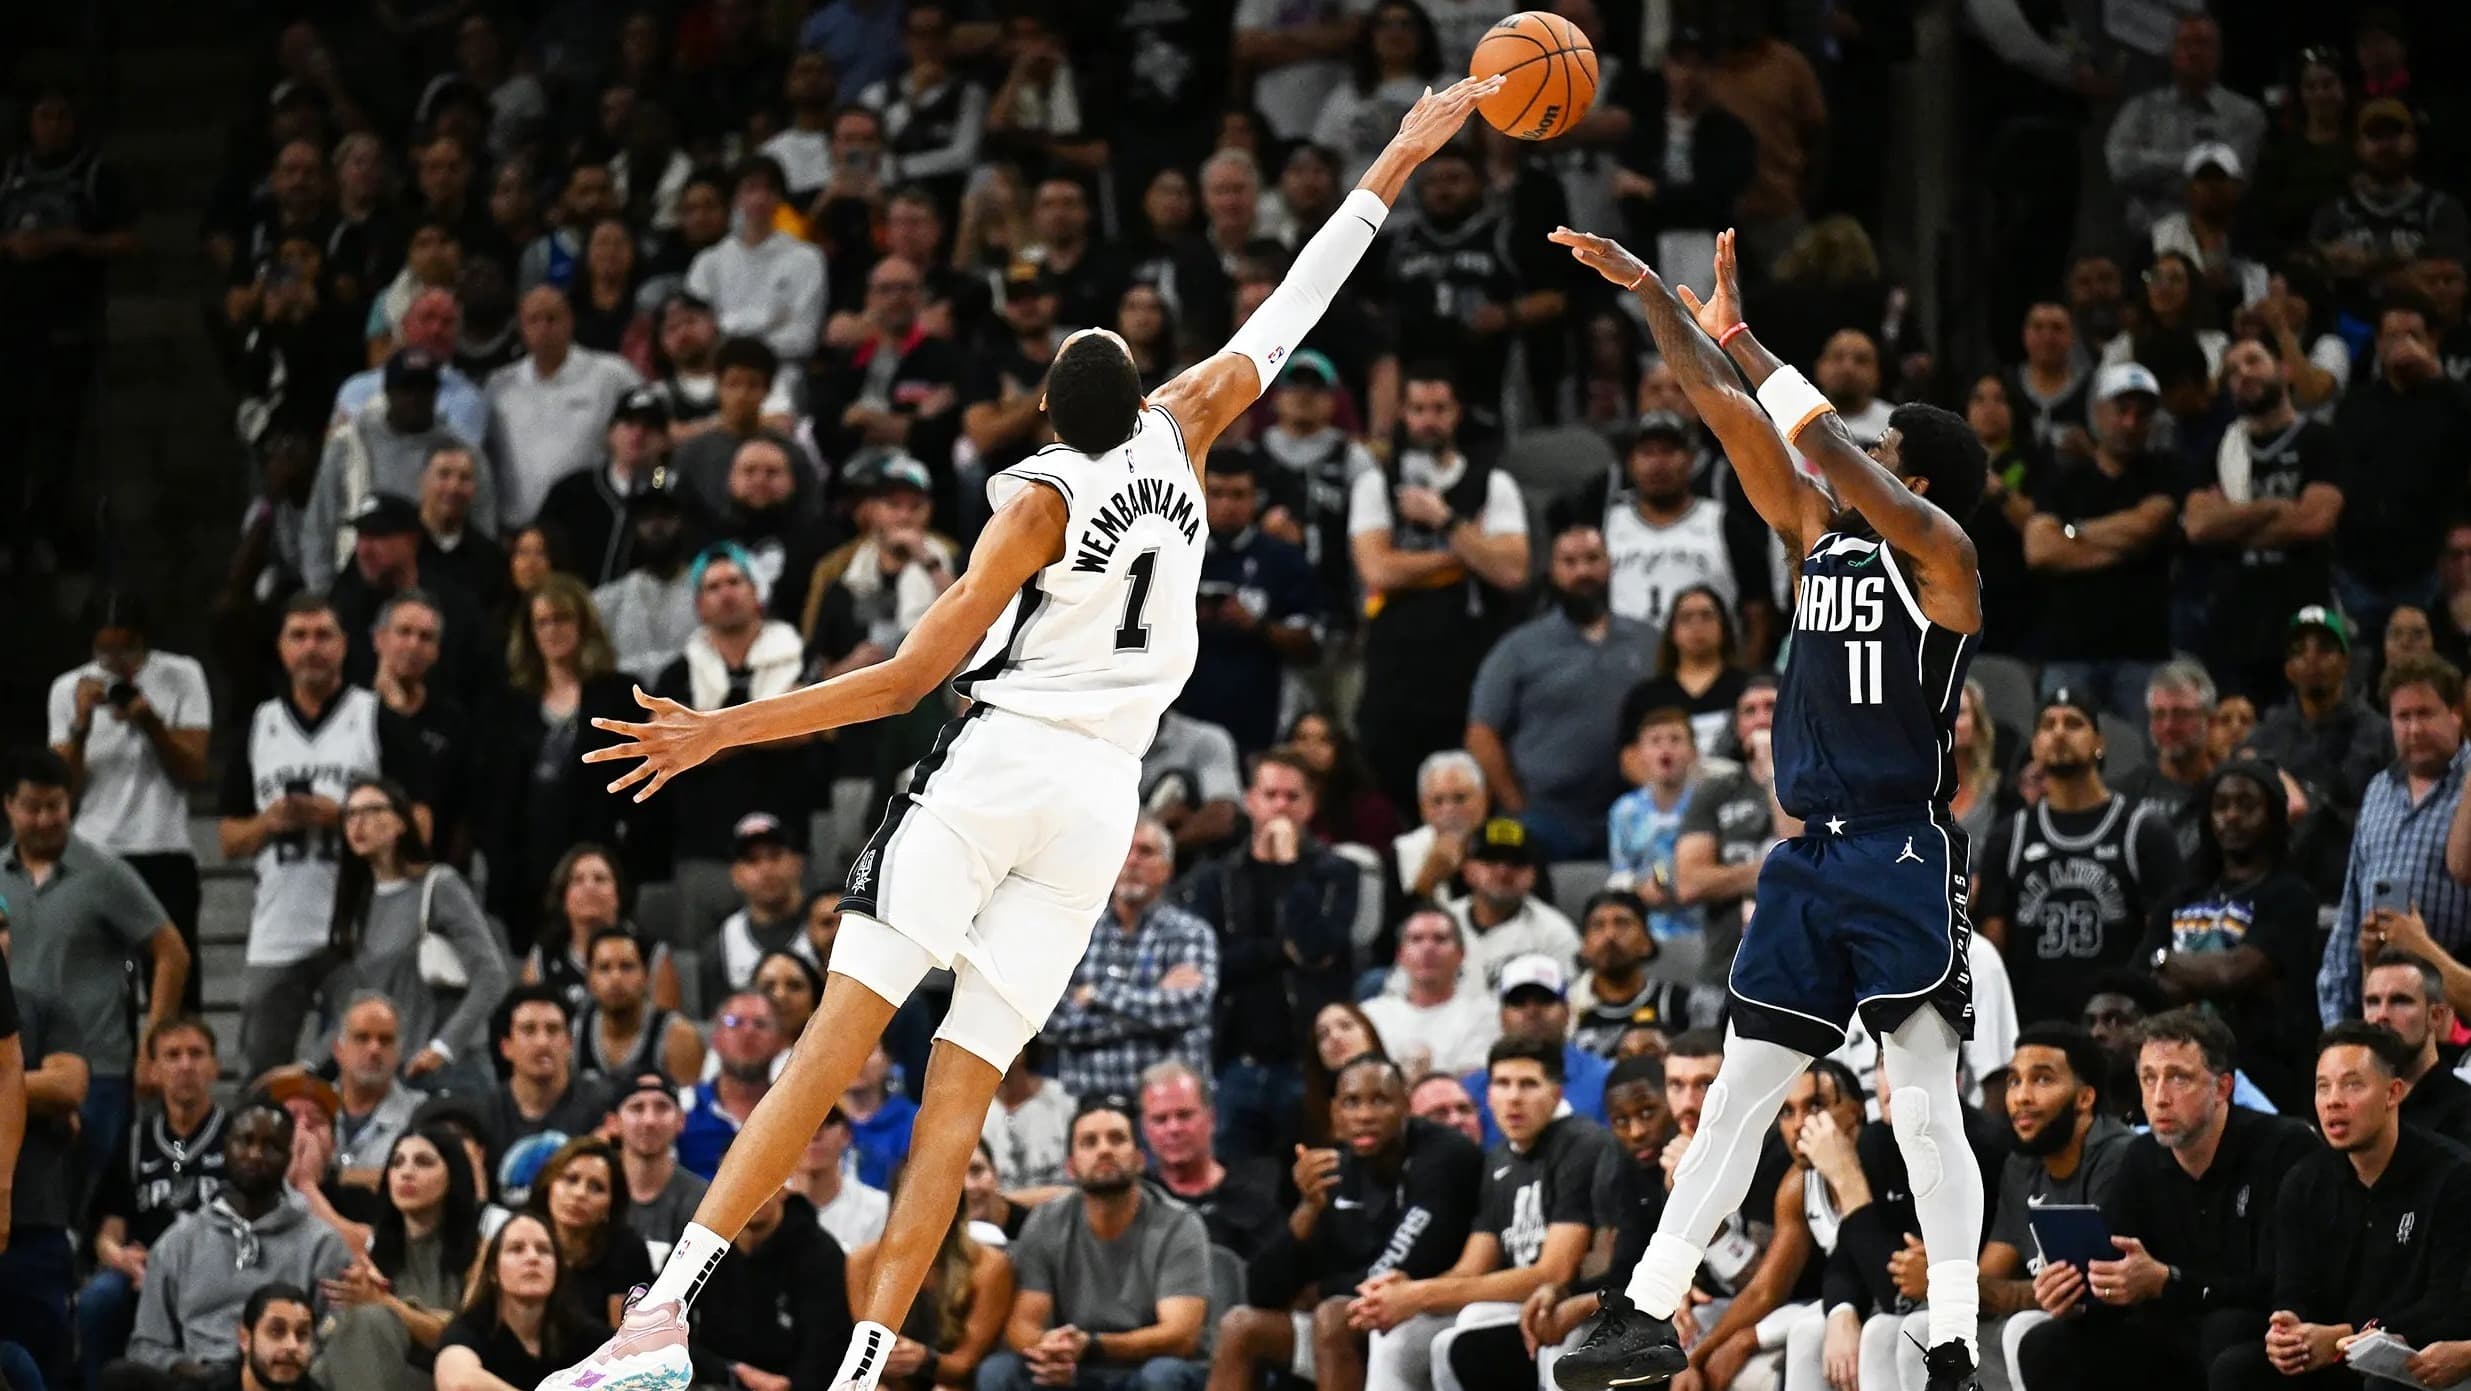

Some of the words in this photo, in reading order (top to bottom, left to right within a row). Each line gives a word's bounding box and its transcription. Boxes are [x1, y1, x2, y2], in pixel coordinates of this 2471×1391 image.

[1071, 478, 1199, 574] WEMBANYAMA
[1113, 546, 1160, 655] 1
[1844, 640, 1883, 704] 11
[2036, 900, 2104, 959] 33
